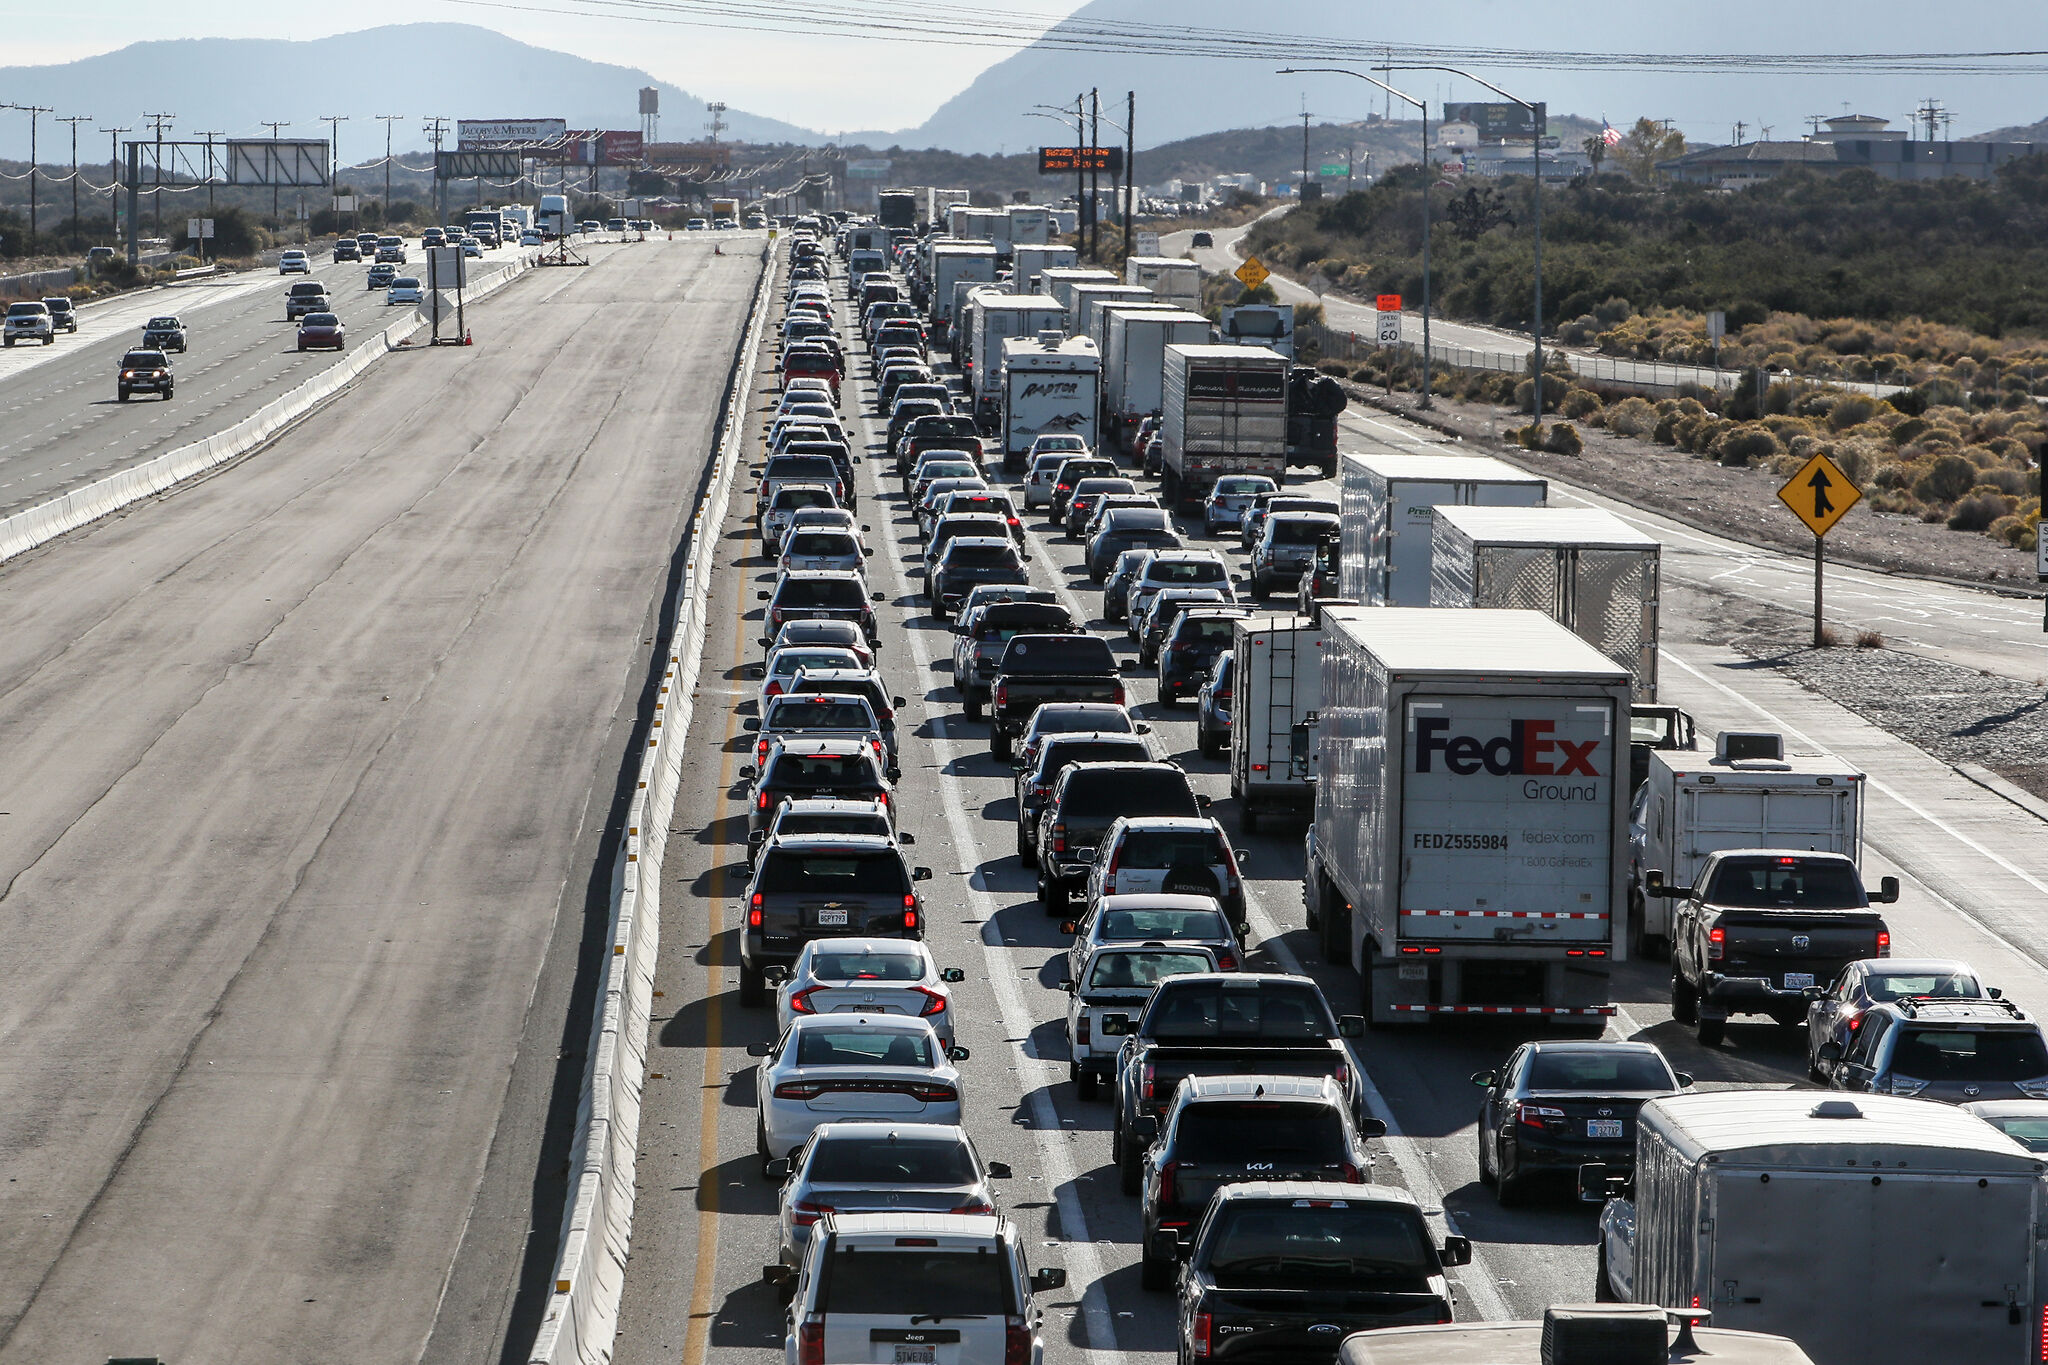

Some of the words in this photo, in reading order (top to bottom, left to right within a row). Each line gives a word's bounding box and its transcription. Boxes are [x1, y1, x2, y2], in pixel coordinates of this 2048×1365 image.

[461, 124, 491, 136] JACOBY
[492, 126, 499, 136] &
[501, 125, 537, 136] MEYERS
[1381, 330, 1397, 341] 60
[1021, 382, 1078, 400] RAPTOR
[1415, 717, 1600, 776] FedEx
[1523, 779, 1596, 802] Ground
[1413, 833, 1508, 851] FEDZ555984
[1521, 829, 1595, 844] fedex.com
[1174, 884, 1211, 893] HONDA
[1246, 1162, 1273, 1171] KIA
